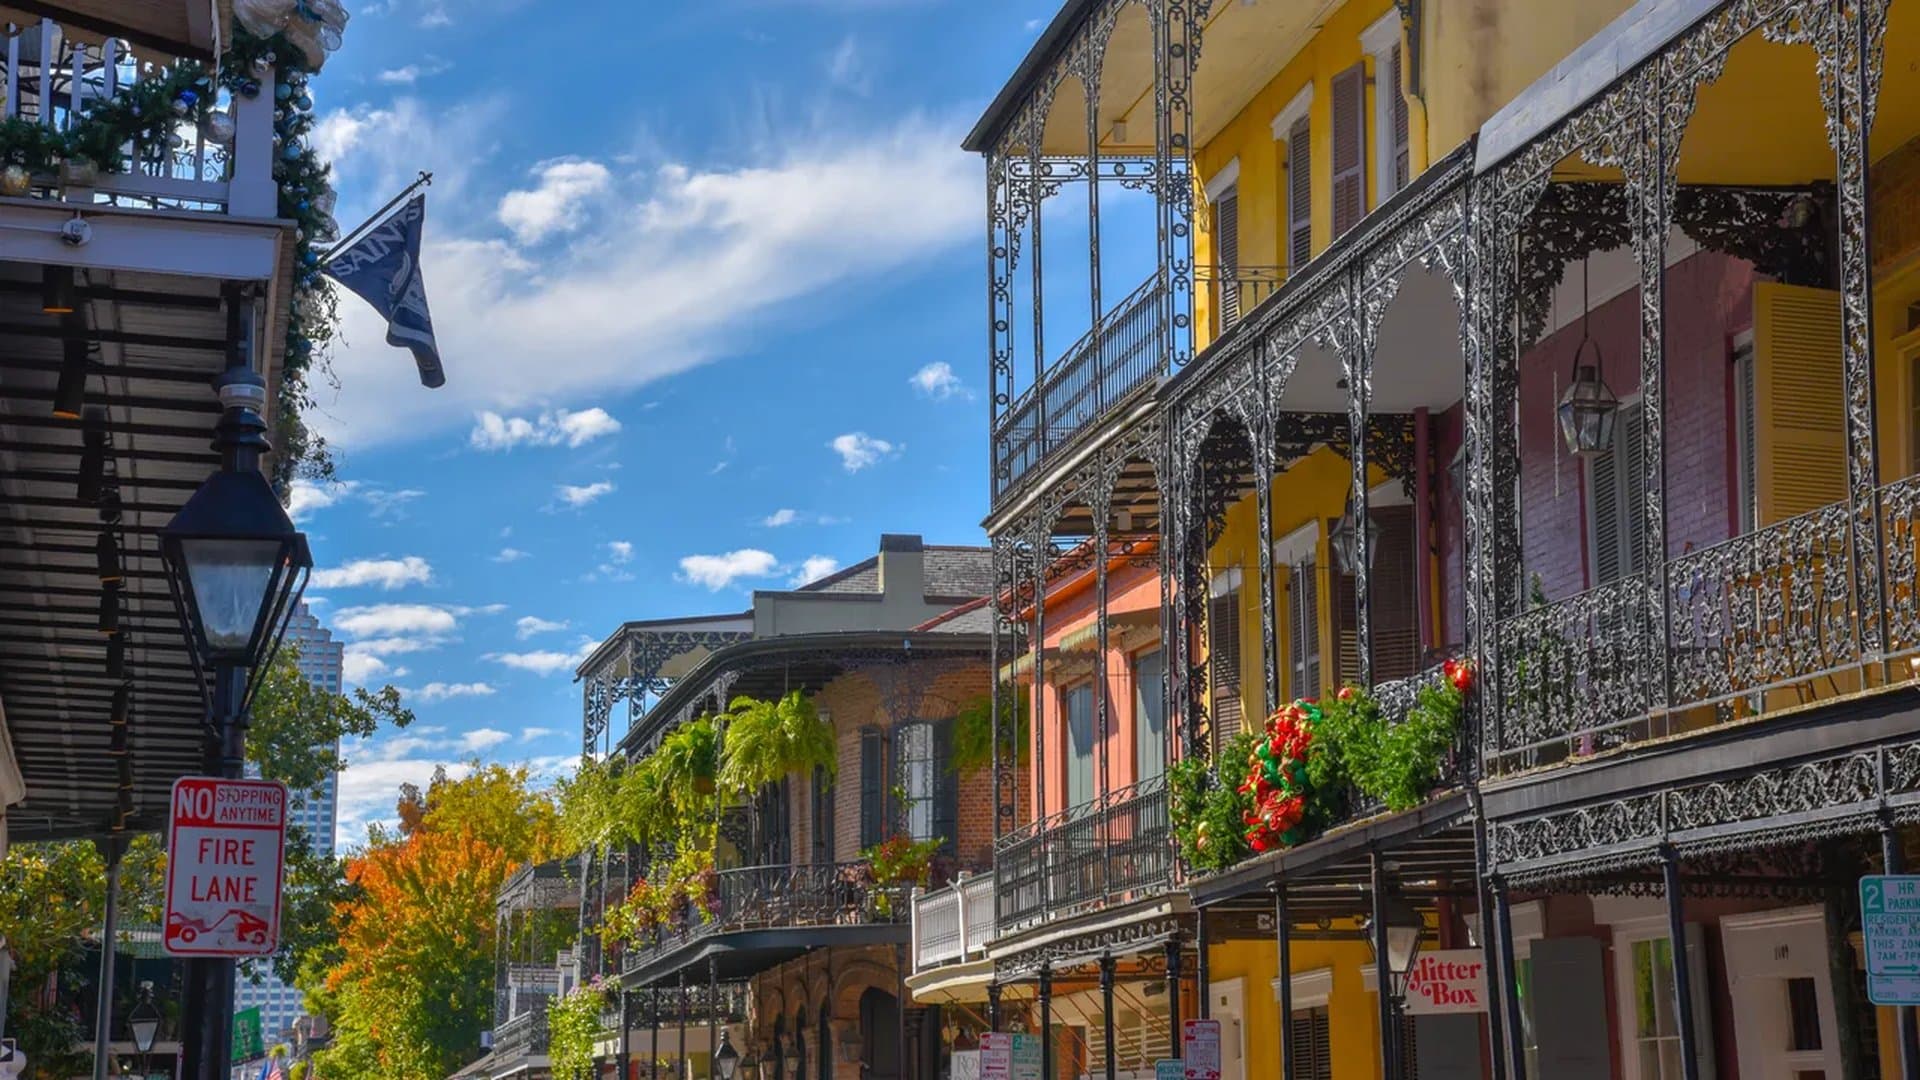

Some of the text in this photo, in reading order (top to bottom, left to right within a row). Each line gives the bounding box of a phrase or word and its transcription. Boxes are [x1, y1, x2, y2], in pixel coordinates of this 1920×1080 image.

[177, 785, 213, 819] NO
[217, 787, 281, 806] STOPPING
[220, 806, 276, 823] ANYTIME
[198, 838, 256, 866] FIRE
[191, 875, 259, 903] LANE
[1865, 884, 1880, 909] 2
[1897, 882, 1914, 895] HR
[1873, 939, 1896, 950] THIS
[1421, 982, 1478, 1005] Box
